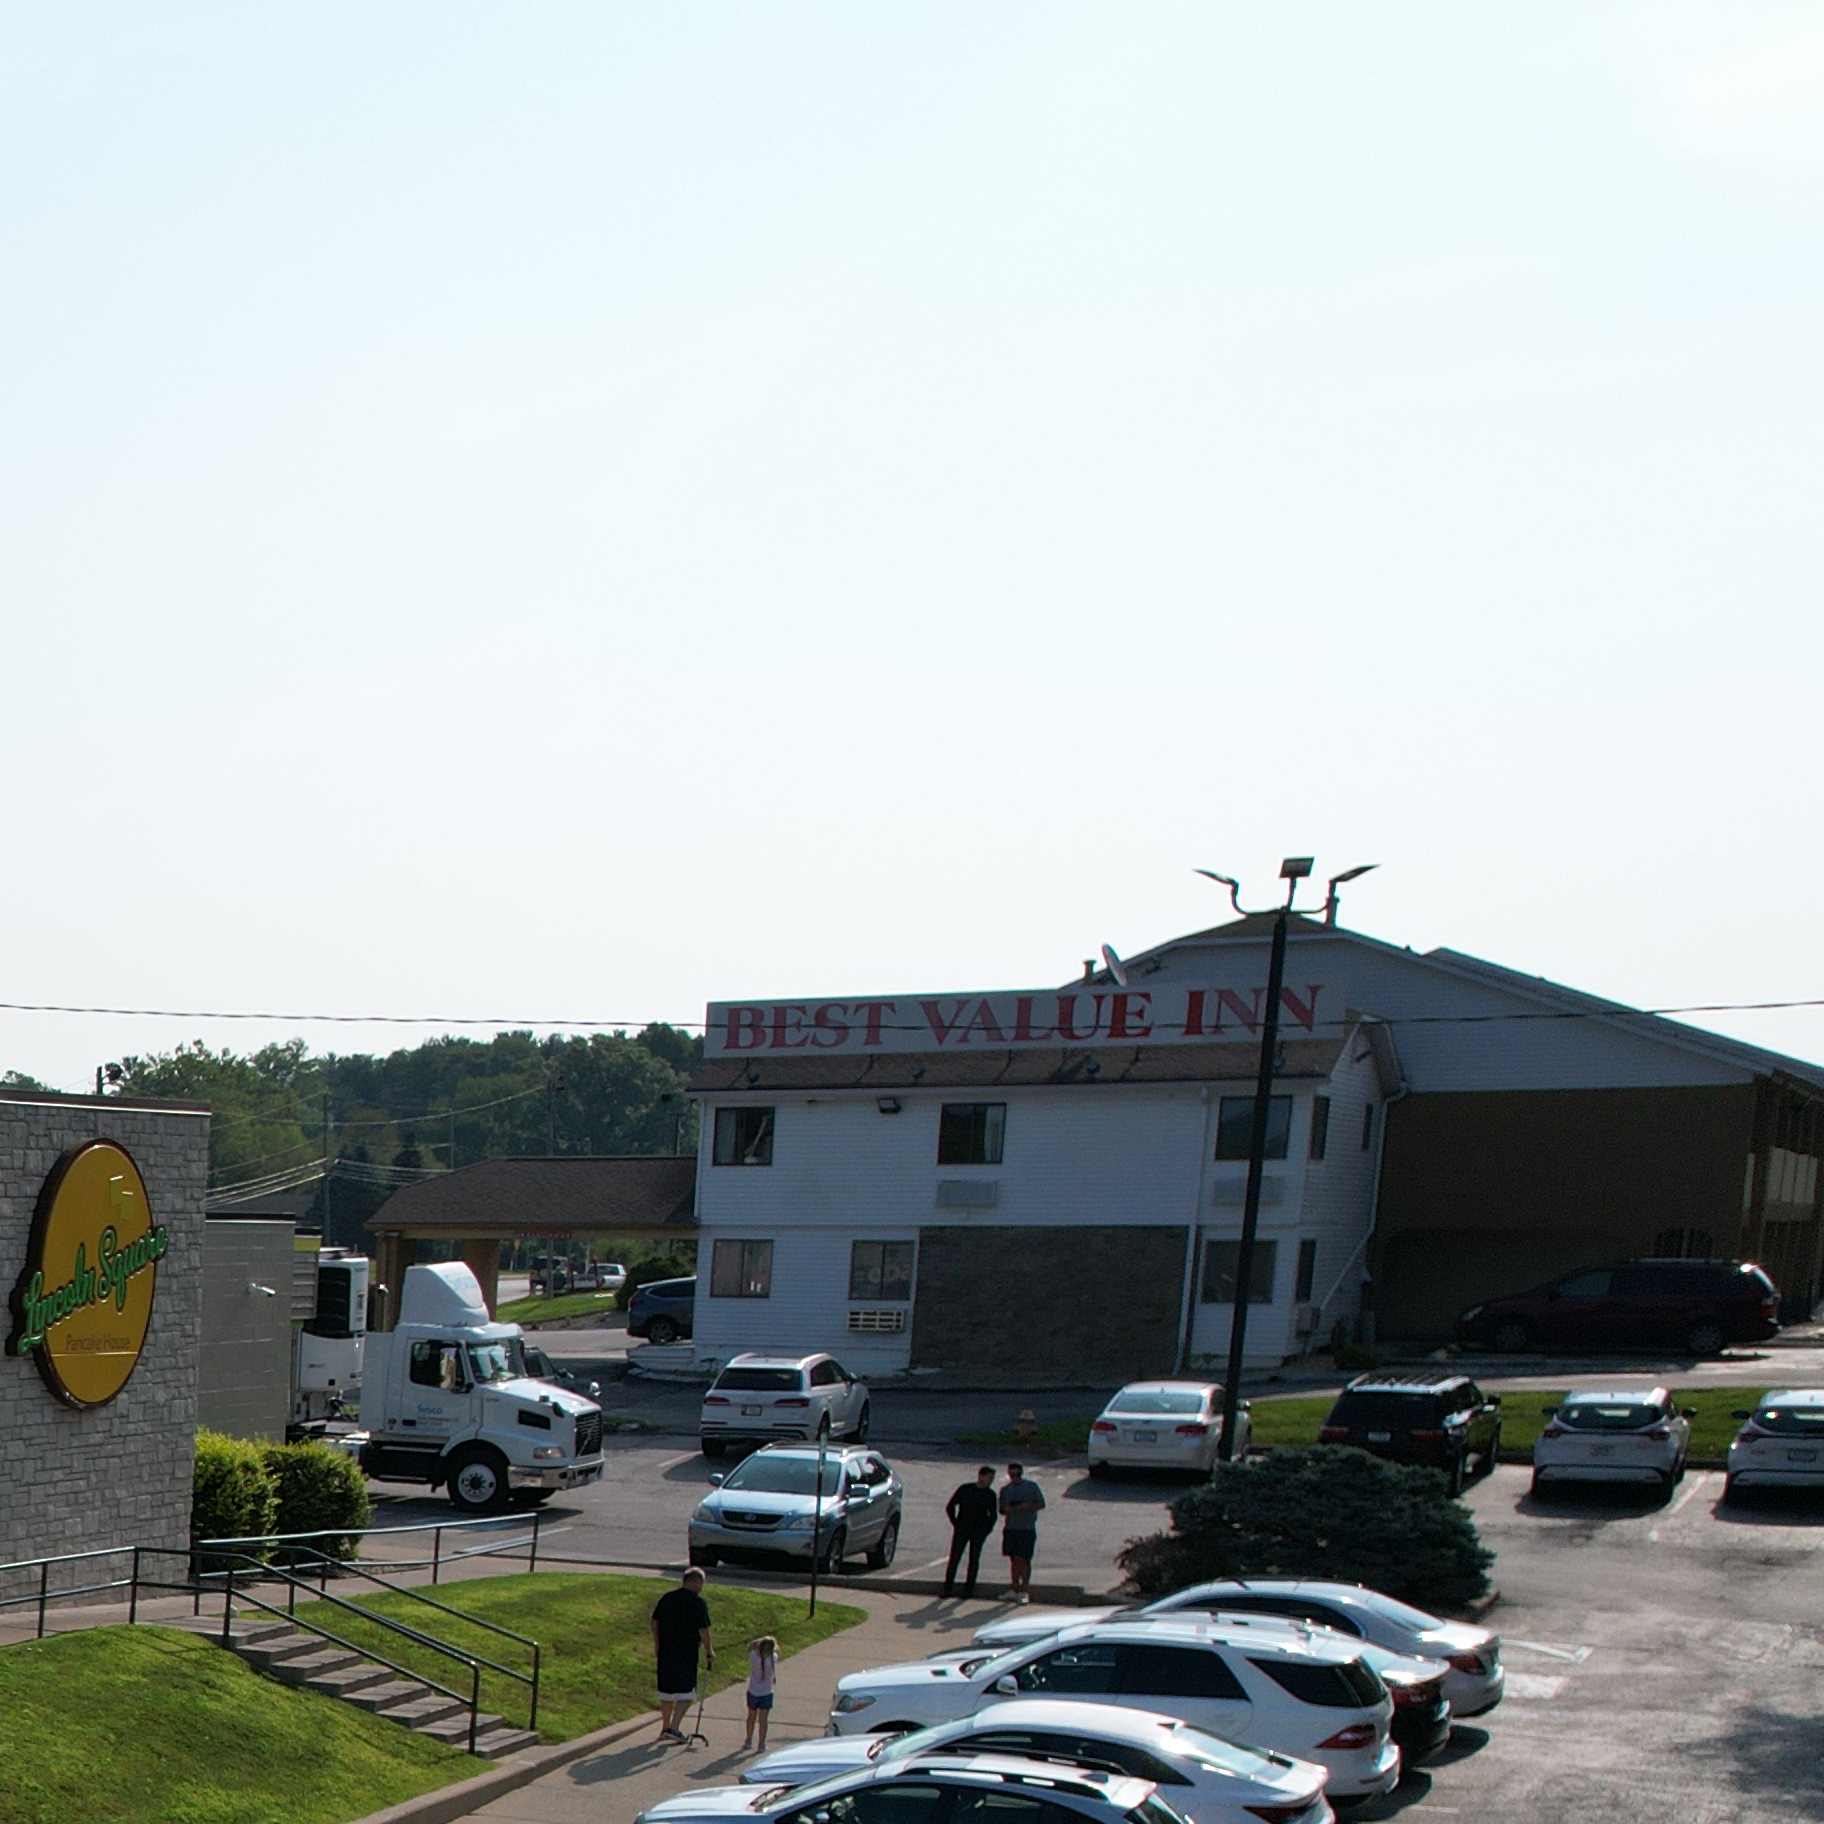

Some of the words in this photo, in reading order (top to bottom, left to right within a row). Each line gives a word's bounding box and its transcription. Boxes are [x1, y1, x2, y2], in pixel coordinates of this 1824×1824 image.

[723, 1002, 897, 1050] BEST
[920, 993, 1153, 1046] VALUE
[1183, 984, 1322, 1037] INN
[17, 1242, 96, 1354] Lincoln
[97, 1225, 169, 1314] Square
[65, 1333, 101, 1350] Pancake
[103, 1332, 131, 1350] House
[417, 1403, 443, 1415] Sysco
